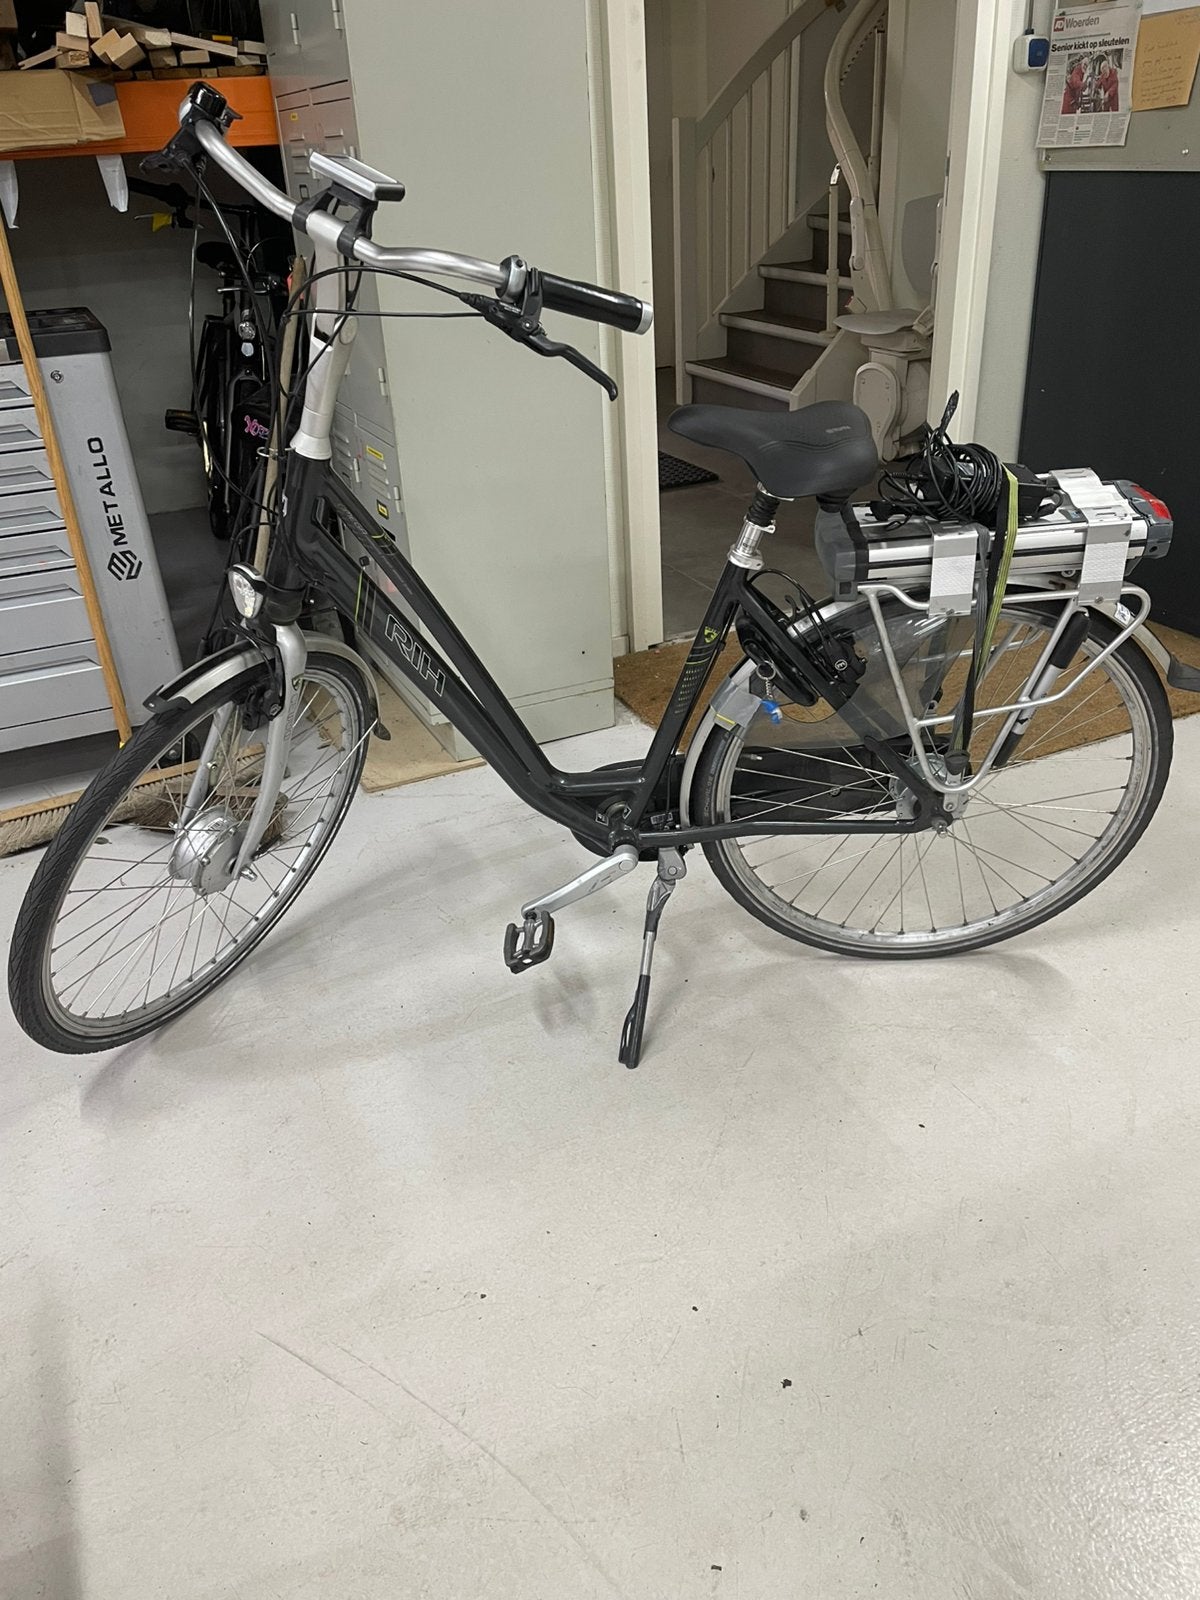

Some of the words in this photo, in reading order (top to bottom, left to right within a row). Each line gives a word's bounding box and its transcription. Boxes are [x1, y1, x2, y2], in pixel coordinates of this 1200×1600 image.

[1051, 43, 1074, 52] Senior
[1074, 41, 1089, 51] kickt
[1098, 36, 1130, 47] sleutelen
[1065, 16, 1100, 29] Woerden
[87, 437, 128, 546] METALLO
[385, 614, 446, 697] RIH
